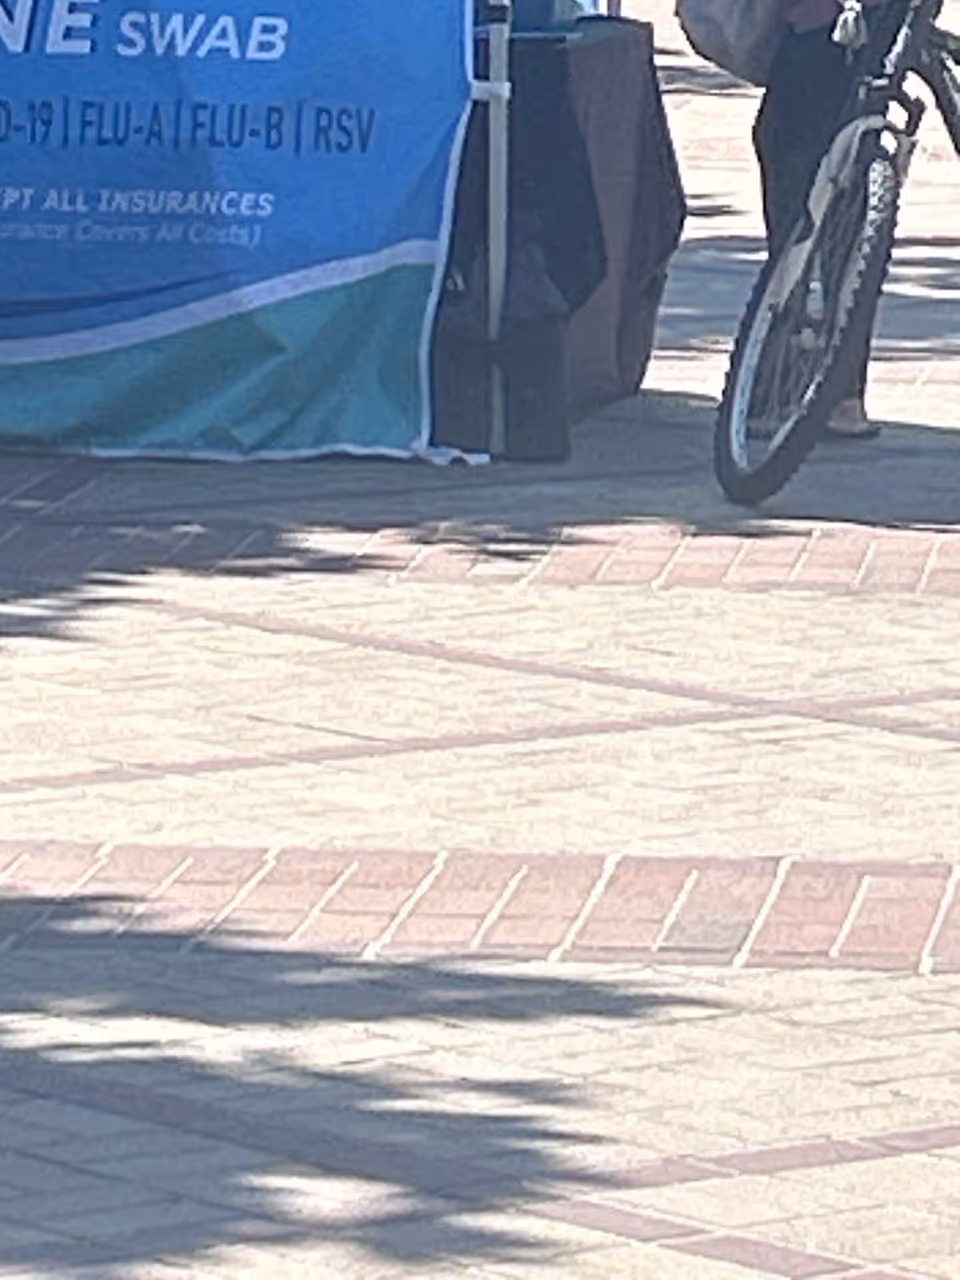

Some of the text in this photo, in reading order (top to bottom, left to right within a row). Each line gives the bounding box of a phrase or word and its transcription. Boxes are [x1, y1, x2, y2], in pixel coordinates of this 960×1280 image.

[116, 11, 288, 61] SWAB
[79, 99, 166, 147] FLU-A
[191, 102, 284, 150] FLU-B
[314, 105, 376, 153] RSV
[41, 188, 89, 211] ALL
[98, 190, 274, 216] INSURANCES
